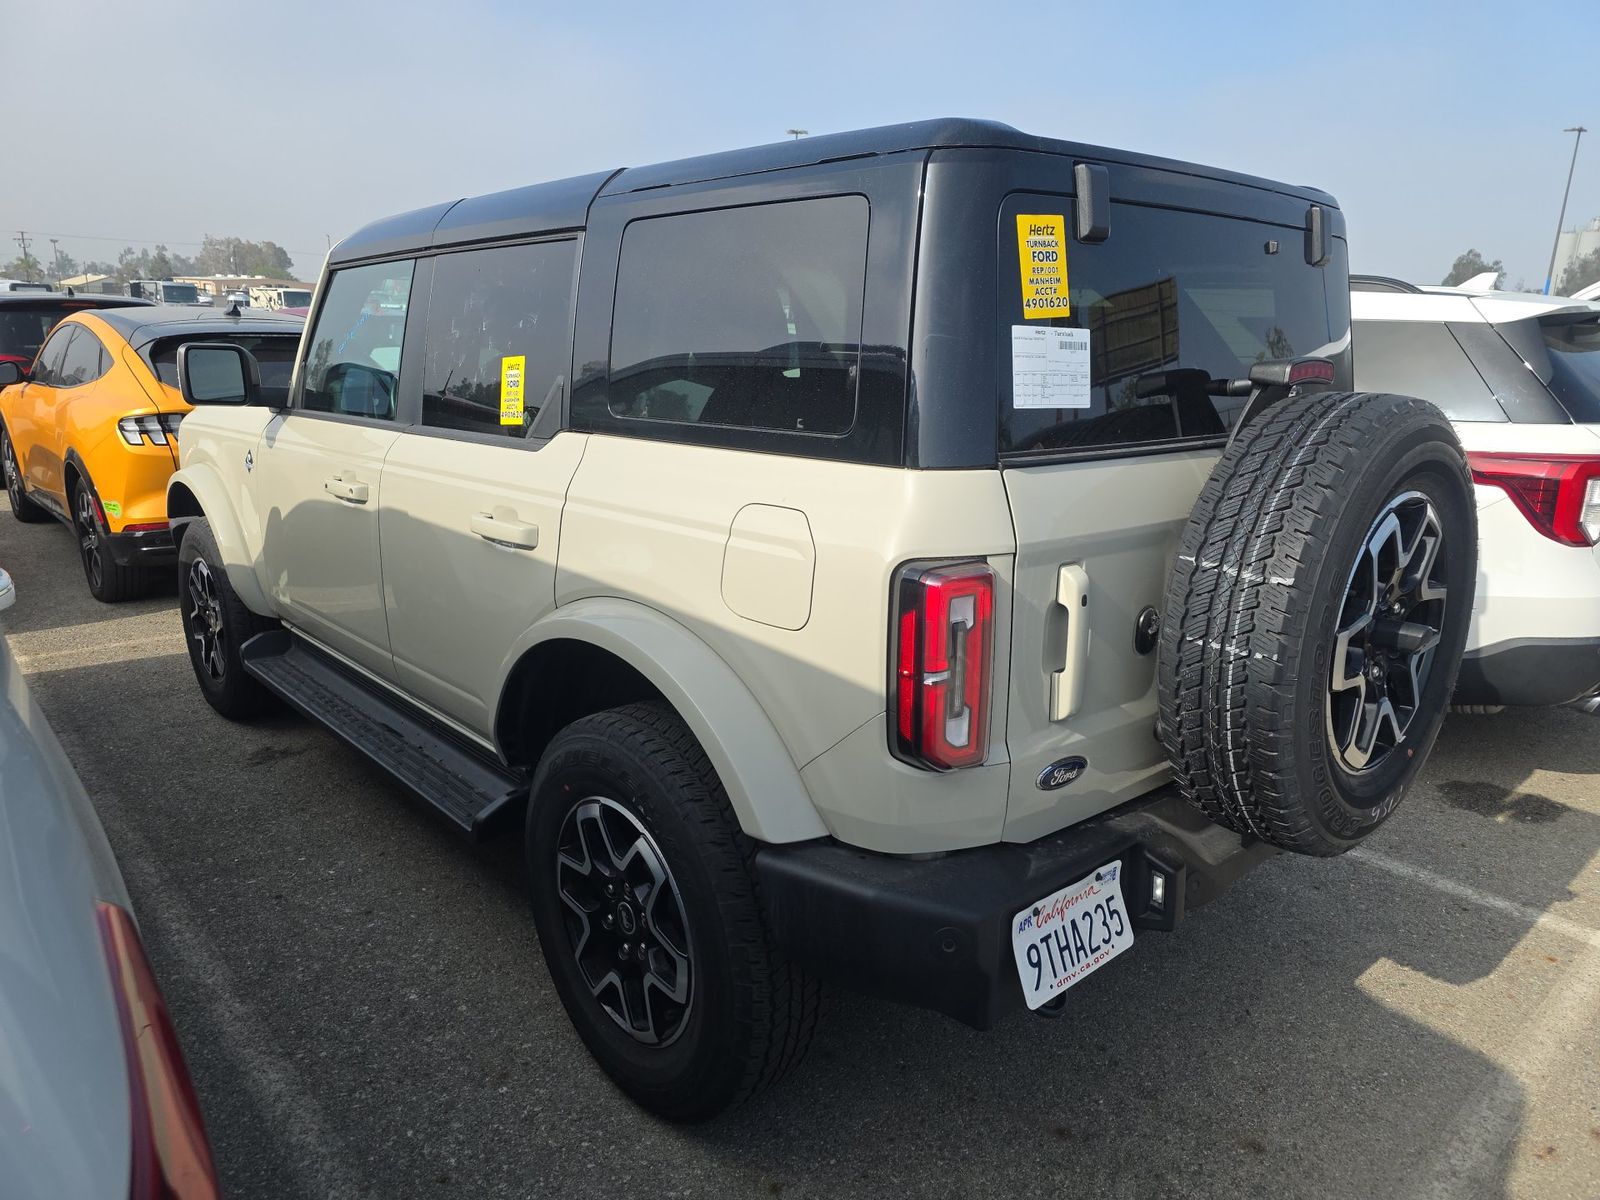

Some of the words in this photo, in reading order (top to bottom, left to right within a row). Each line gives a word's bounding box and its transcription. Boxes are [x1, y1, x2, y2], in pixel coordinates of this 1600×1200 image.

[1029, 224, 1055, 236] Hertz
[1026, 240, 1059, 248] TURNBACK
[1032, 251, 1058, 262] FORD
[1032, 266, 1058, 274] REP/001
[1029, 277, 1061, 285] MANHEIM
[1035, 287, 1057, 296] ACCT#
[1025, 297, 1068, 308] 4901620
[507, 380, 520, 388] FORD
[1050, 767, 1078, 786] Ford
[1036, 884, 1101, 929] California
[1018, 915, 1033, 934] APR
[1026, 895, 1124, 992] 9THA235
[1056, 949, 1111, 988] dmv.ca.gov
